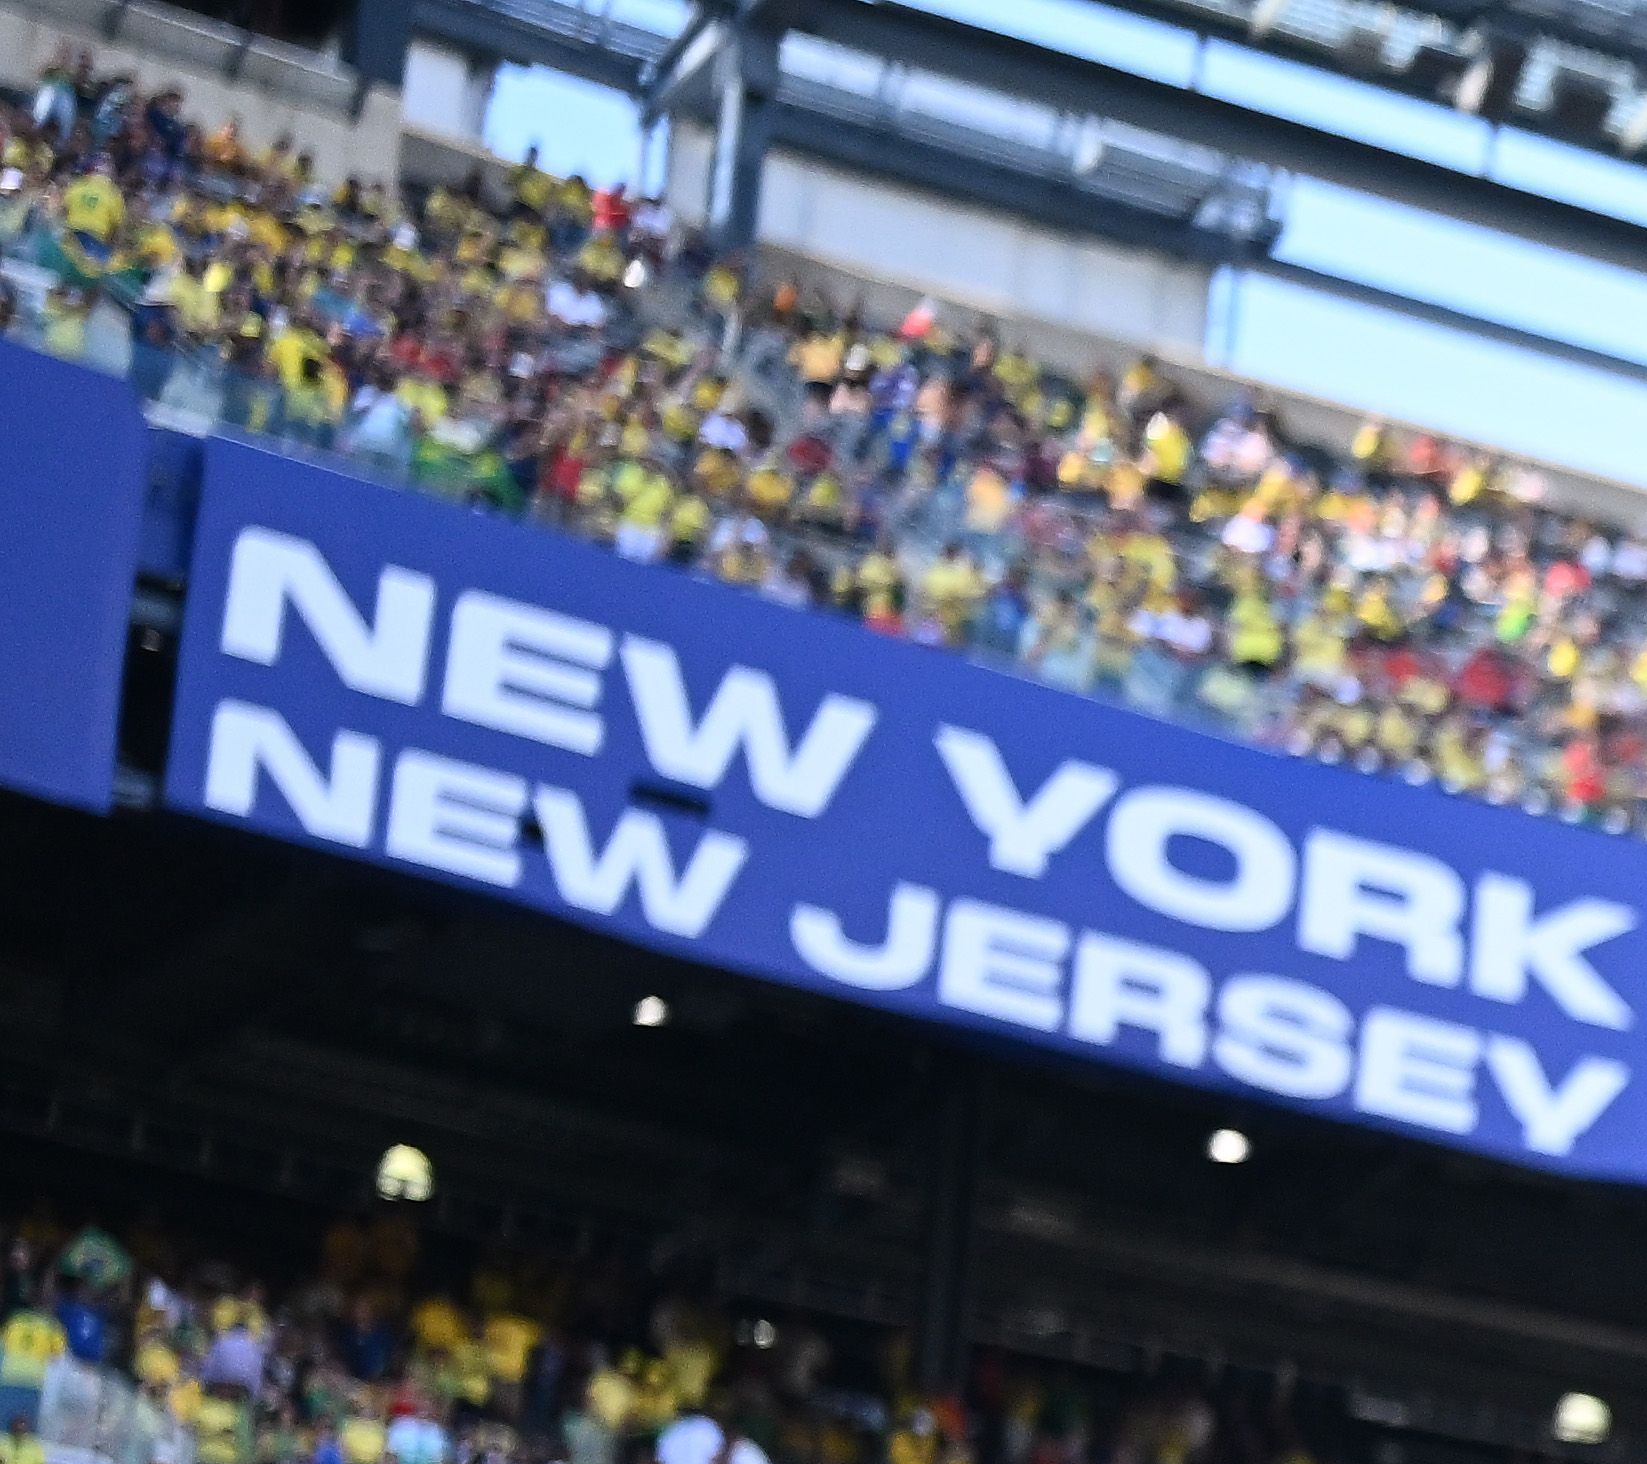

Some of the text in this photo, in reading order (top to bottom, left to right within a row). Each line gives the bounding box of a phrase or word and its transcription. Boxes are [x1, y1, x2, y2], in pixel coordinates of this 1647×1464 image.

[205, 699, 1629, 1156] NEW JERSEY
[221, 524, 1640, 1030] NEW YORK
